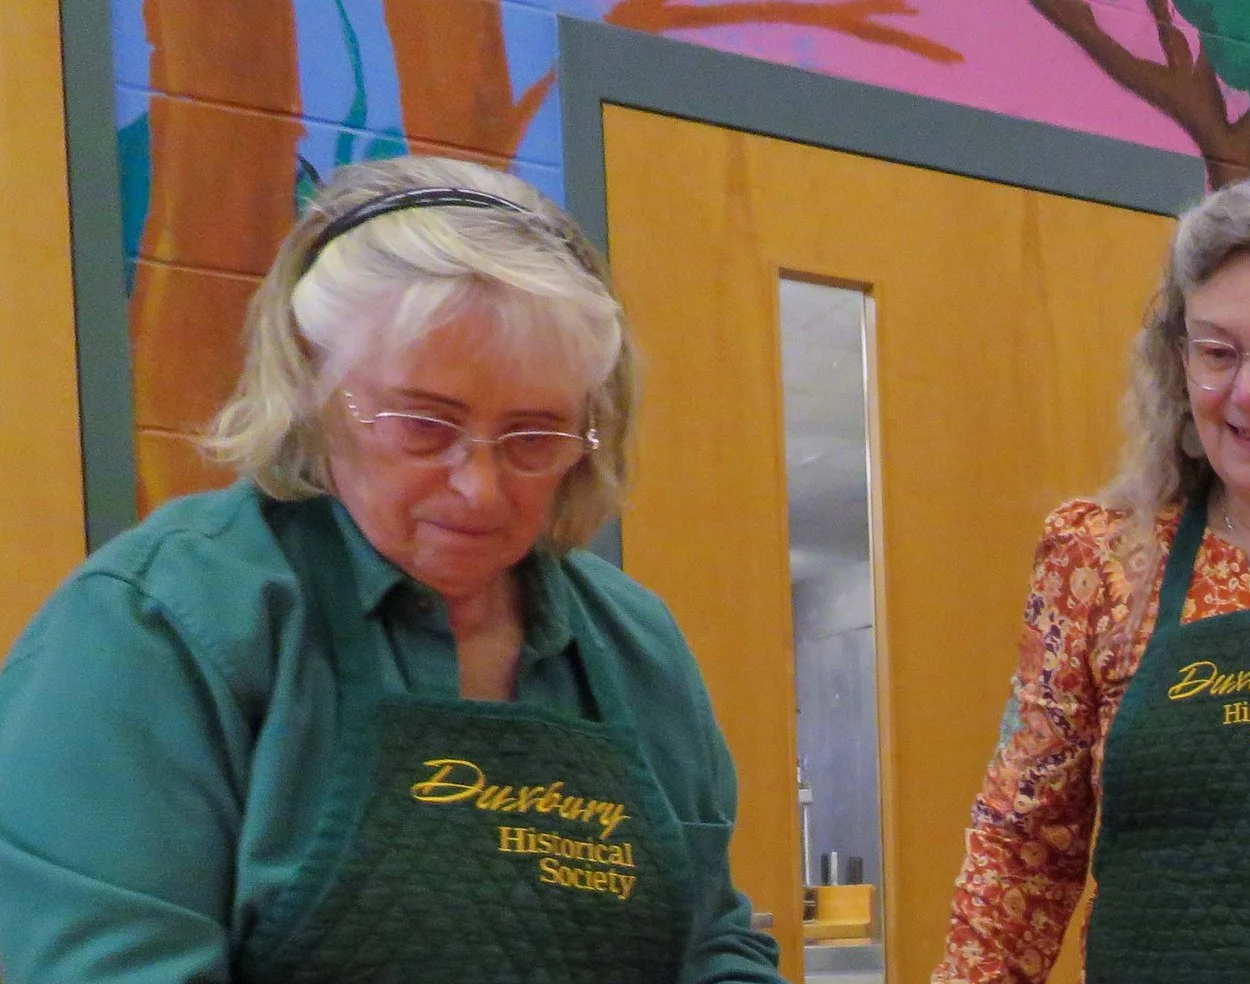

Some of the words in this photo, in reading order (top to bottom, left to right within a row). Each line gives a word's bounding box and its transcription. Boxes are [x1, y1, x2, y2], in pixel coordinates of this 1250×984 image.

[410, 758, 632, 840] Duxbury
[498, 825, 636, 867] Historical
[539, 857, 637, 900] Society
